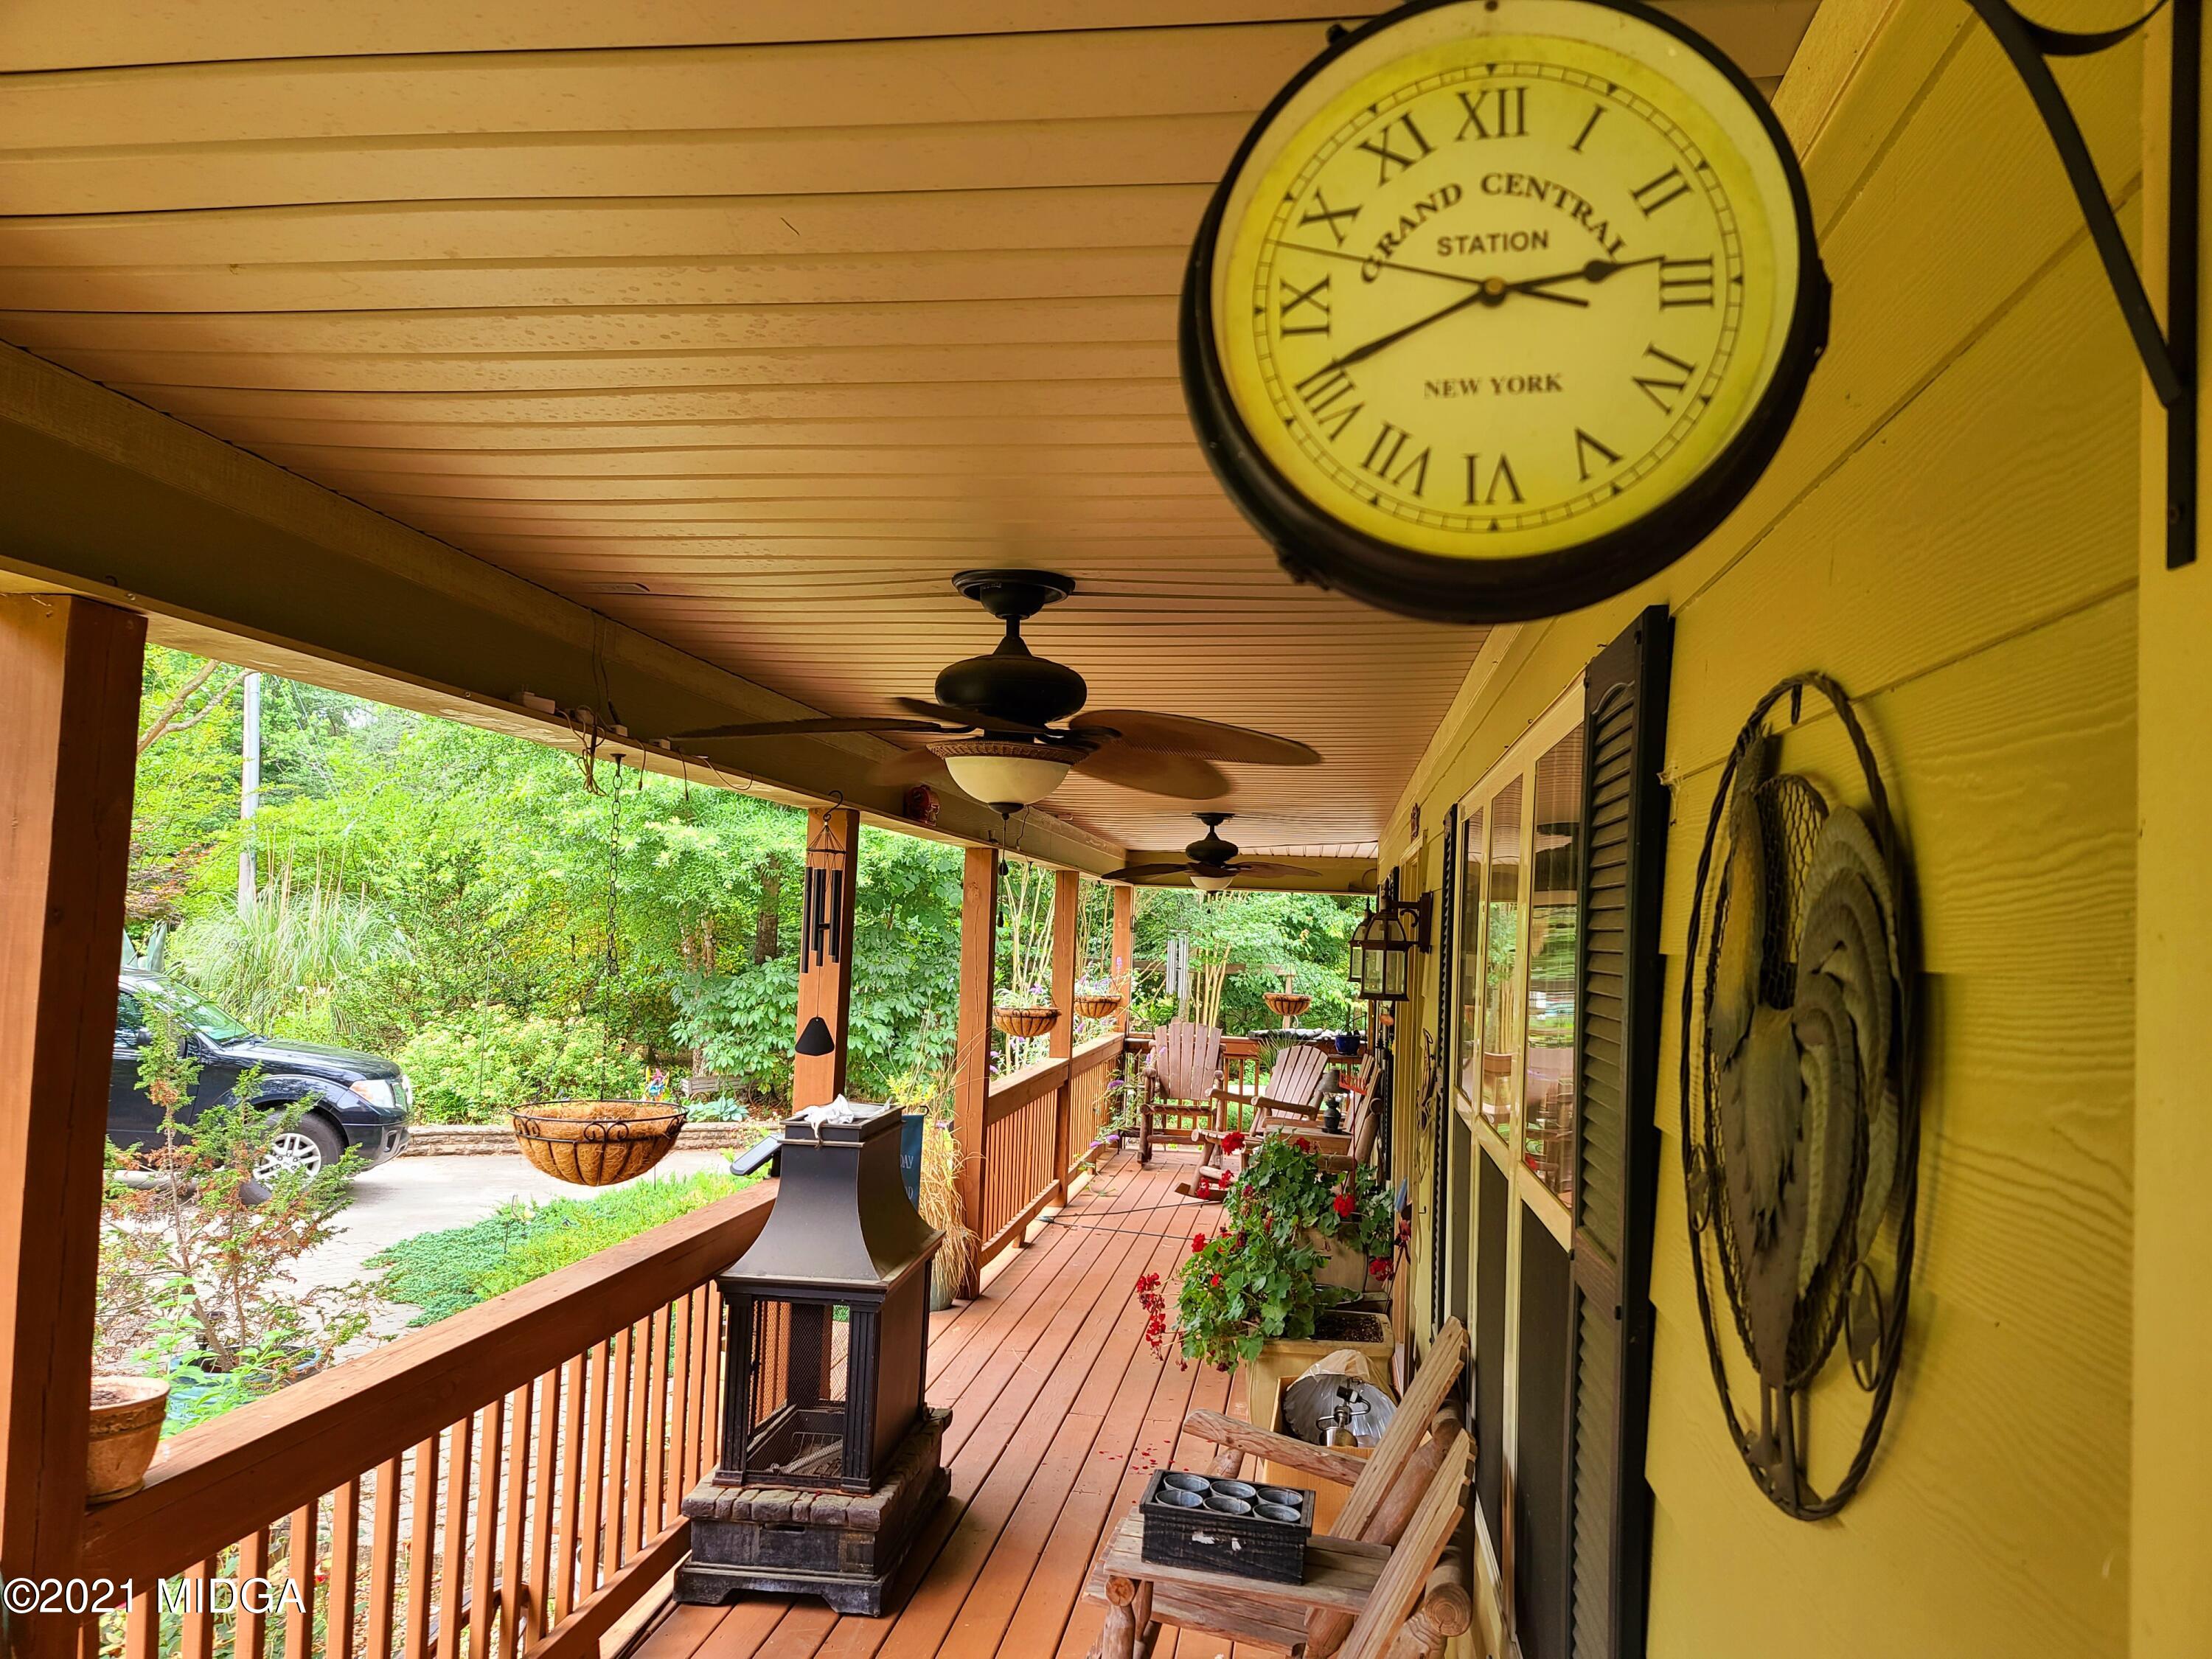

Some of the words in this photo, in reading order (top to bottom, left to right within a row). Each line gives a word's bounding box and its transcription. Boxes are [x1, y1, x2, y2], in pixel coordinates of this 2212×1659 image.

[1455, 86, 1528, 142] XII
[1568, 103, 1607, 153] I
[1354, 110, 1437, 187] XI
[1298, 186, 1362, 246] X
[1630, 164, 1693, 219] II
[1360, 183, 1463, 284] GRAND
[1480, 172, 1627, 264] CENTRAL
[1436, 229, 1550, 257] STATION
[1279, 273, 1331, 339] IX
[1658, 254, 1714, 312] III
[1423, 378, 1480, 399] NEW
[1490, 372, 1564, 395] YORK
[1632, 341, 1697, 416] IV
[1359, 421, 1432, 498] VII
[1462, 453, 1525, 507] VI
[1575, 427, 1624, 484] V
